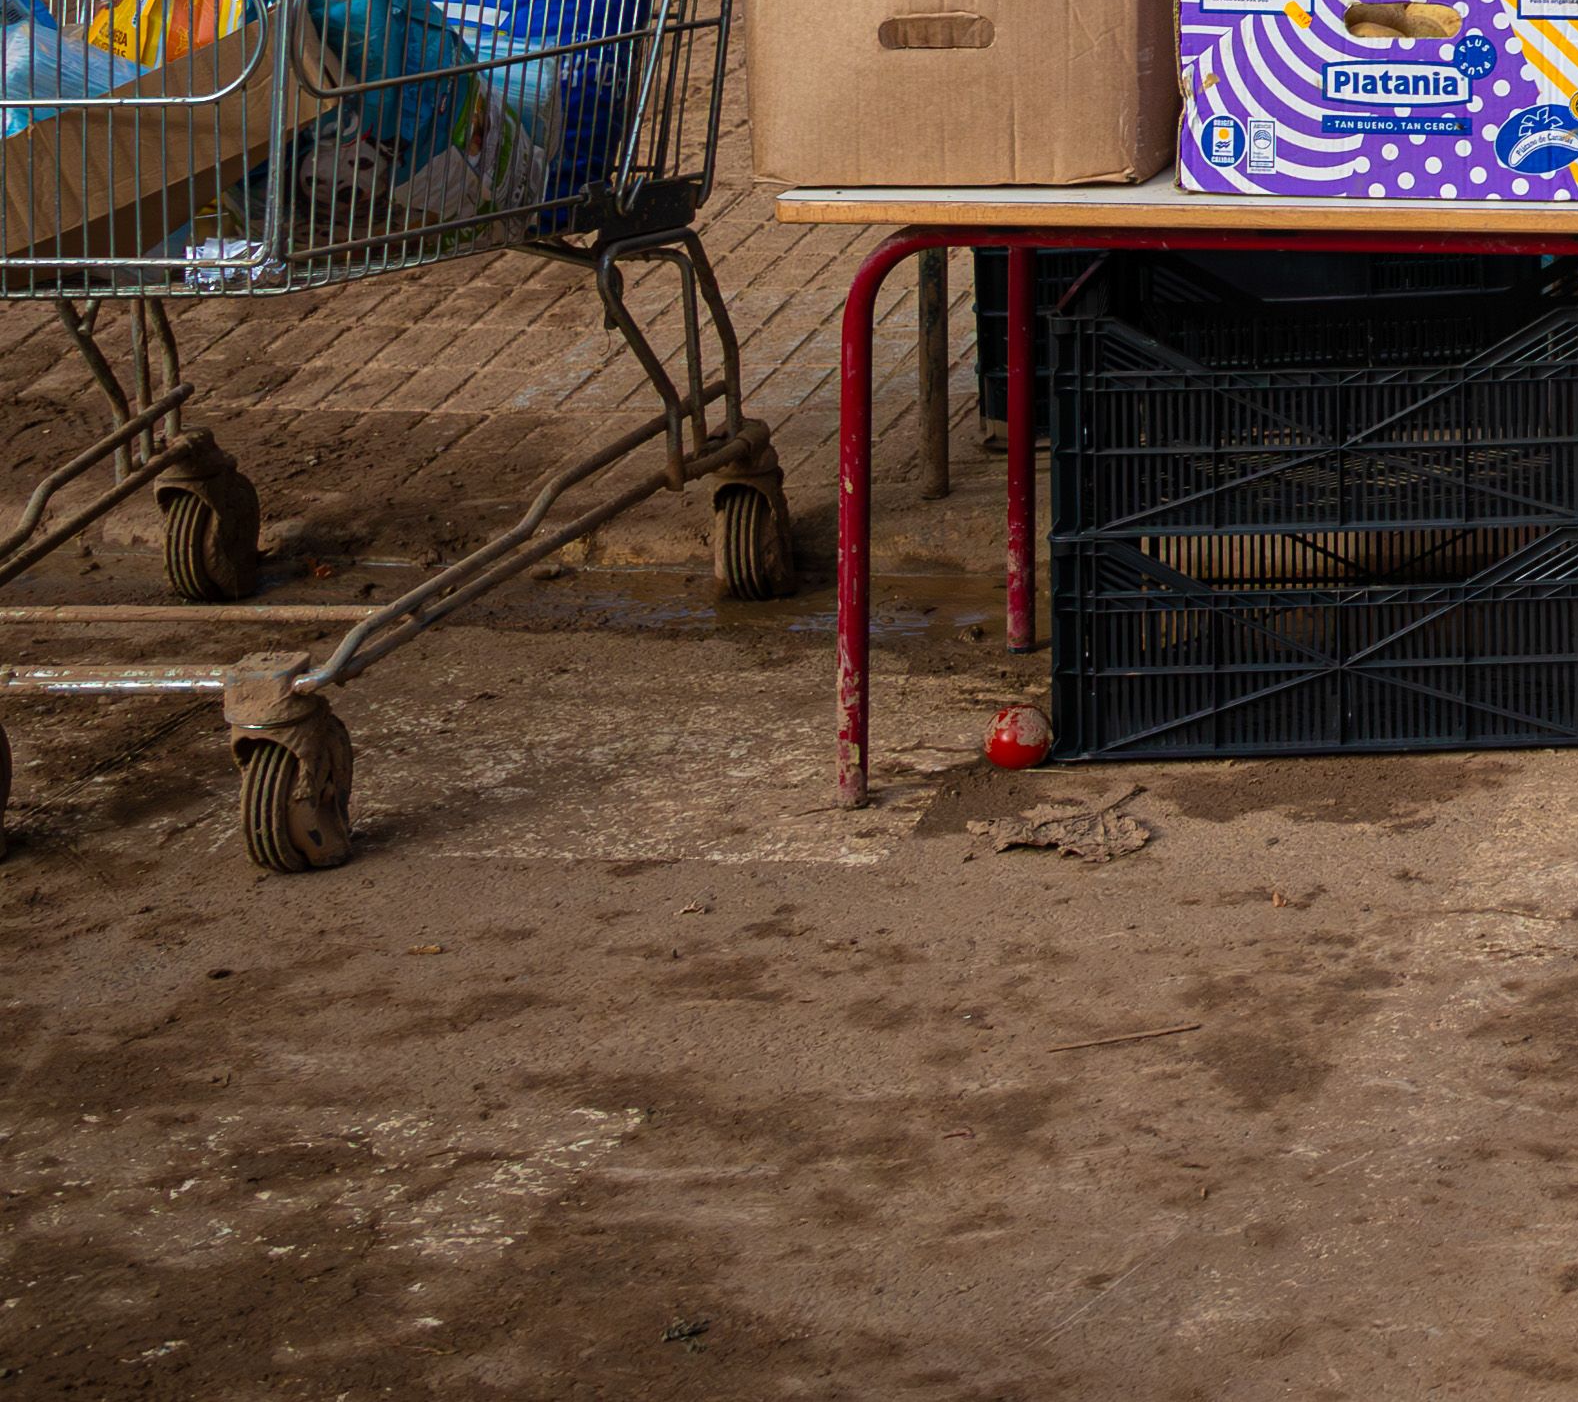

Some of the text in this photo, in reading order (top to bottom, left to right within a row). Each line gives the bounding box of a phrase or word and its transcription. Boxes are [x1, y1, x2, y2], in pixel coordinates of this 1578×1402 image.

[1459, 37, 1491, 55] PLUS
[1334, 68, 1456, 97] Platania
[1334, 120, 1463, 131] TAN BUENO, TAN CERCA
